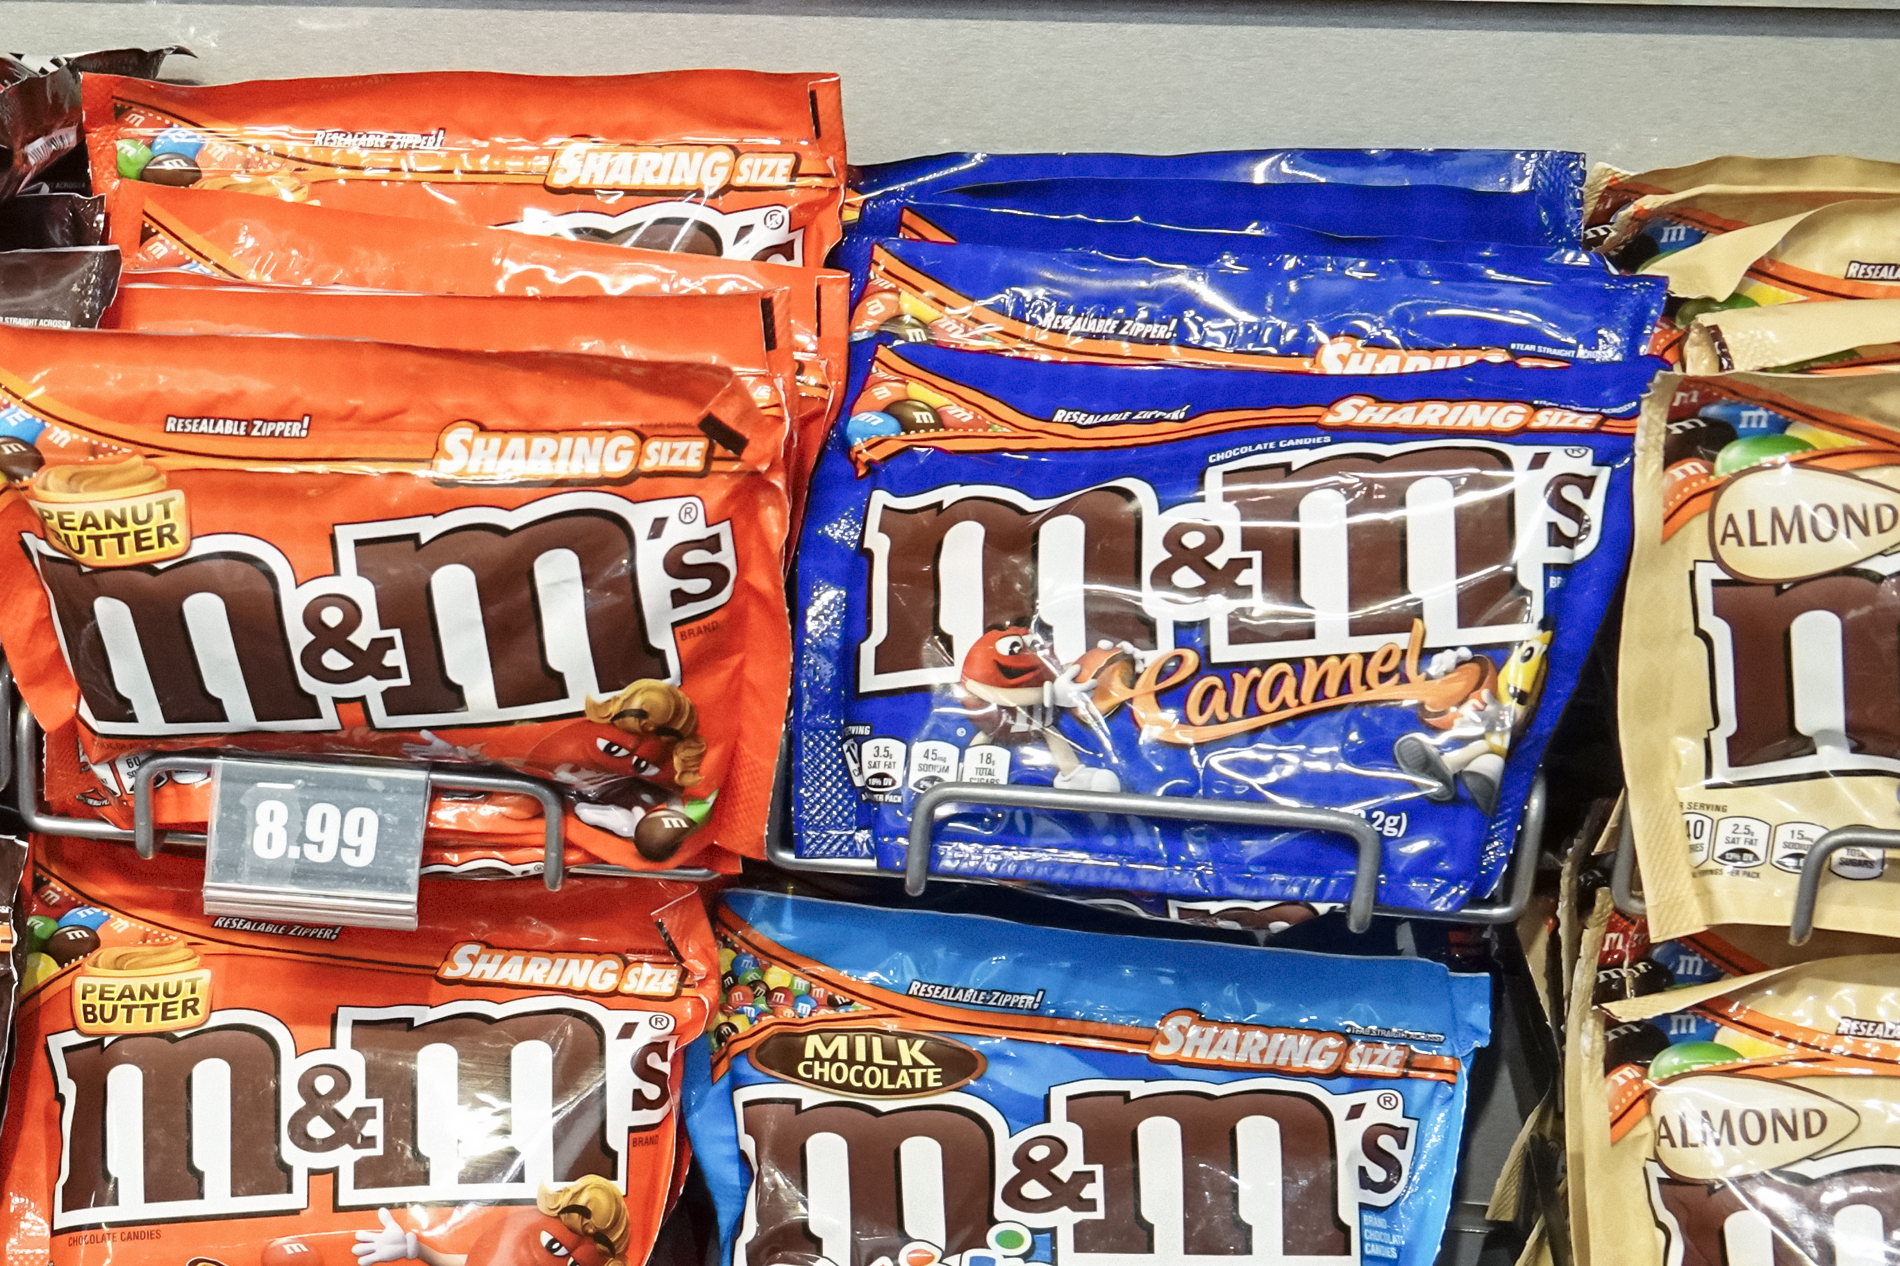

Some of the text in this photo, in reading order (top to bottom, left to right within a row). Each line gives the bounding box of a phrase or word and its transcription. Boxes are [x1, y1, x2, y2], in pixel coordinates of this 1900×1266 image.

[165, 416, 310, 438] RESEALABLE ZIPPER!
[1330, 399, 1600, 429] SHARING SIZE
[439, 429, 706, 475] SHARING SIZE
[1209, 436, 1331, 463] CHOCOLATE CANDIES
[1720, 504, 1898, 546] ALMOND
[1132, 619, 1429, 745] Caramel
[253, 801, 380, 866] 8.99
[444, 945, 678, 994] SHARING SIZE
[80, 977, 201, 1002] PEANUT
[83, 998, 201, 1023] BUTTER
[805, 1034, 933, 1065] MILK
[1153, 1019, 1405, 1073] SHARING SIZE
[797, 1062, 941, 1090] CHOCOLATE
[1655, 1108, 1828, 1148] ALMOND
